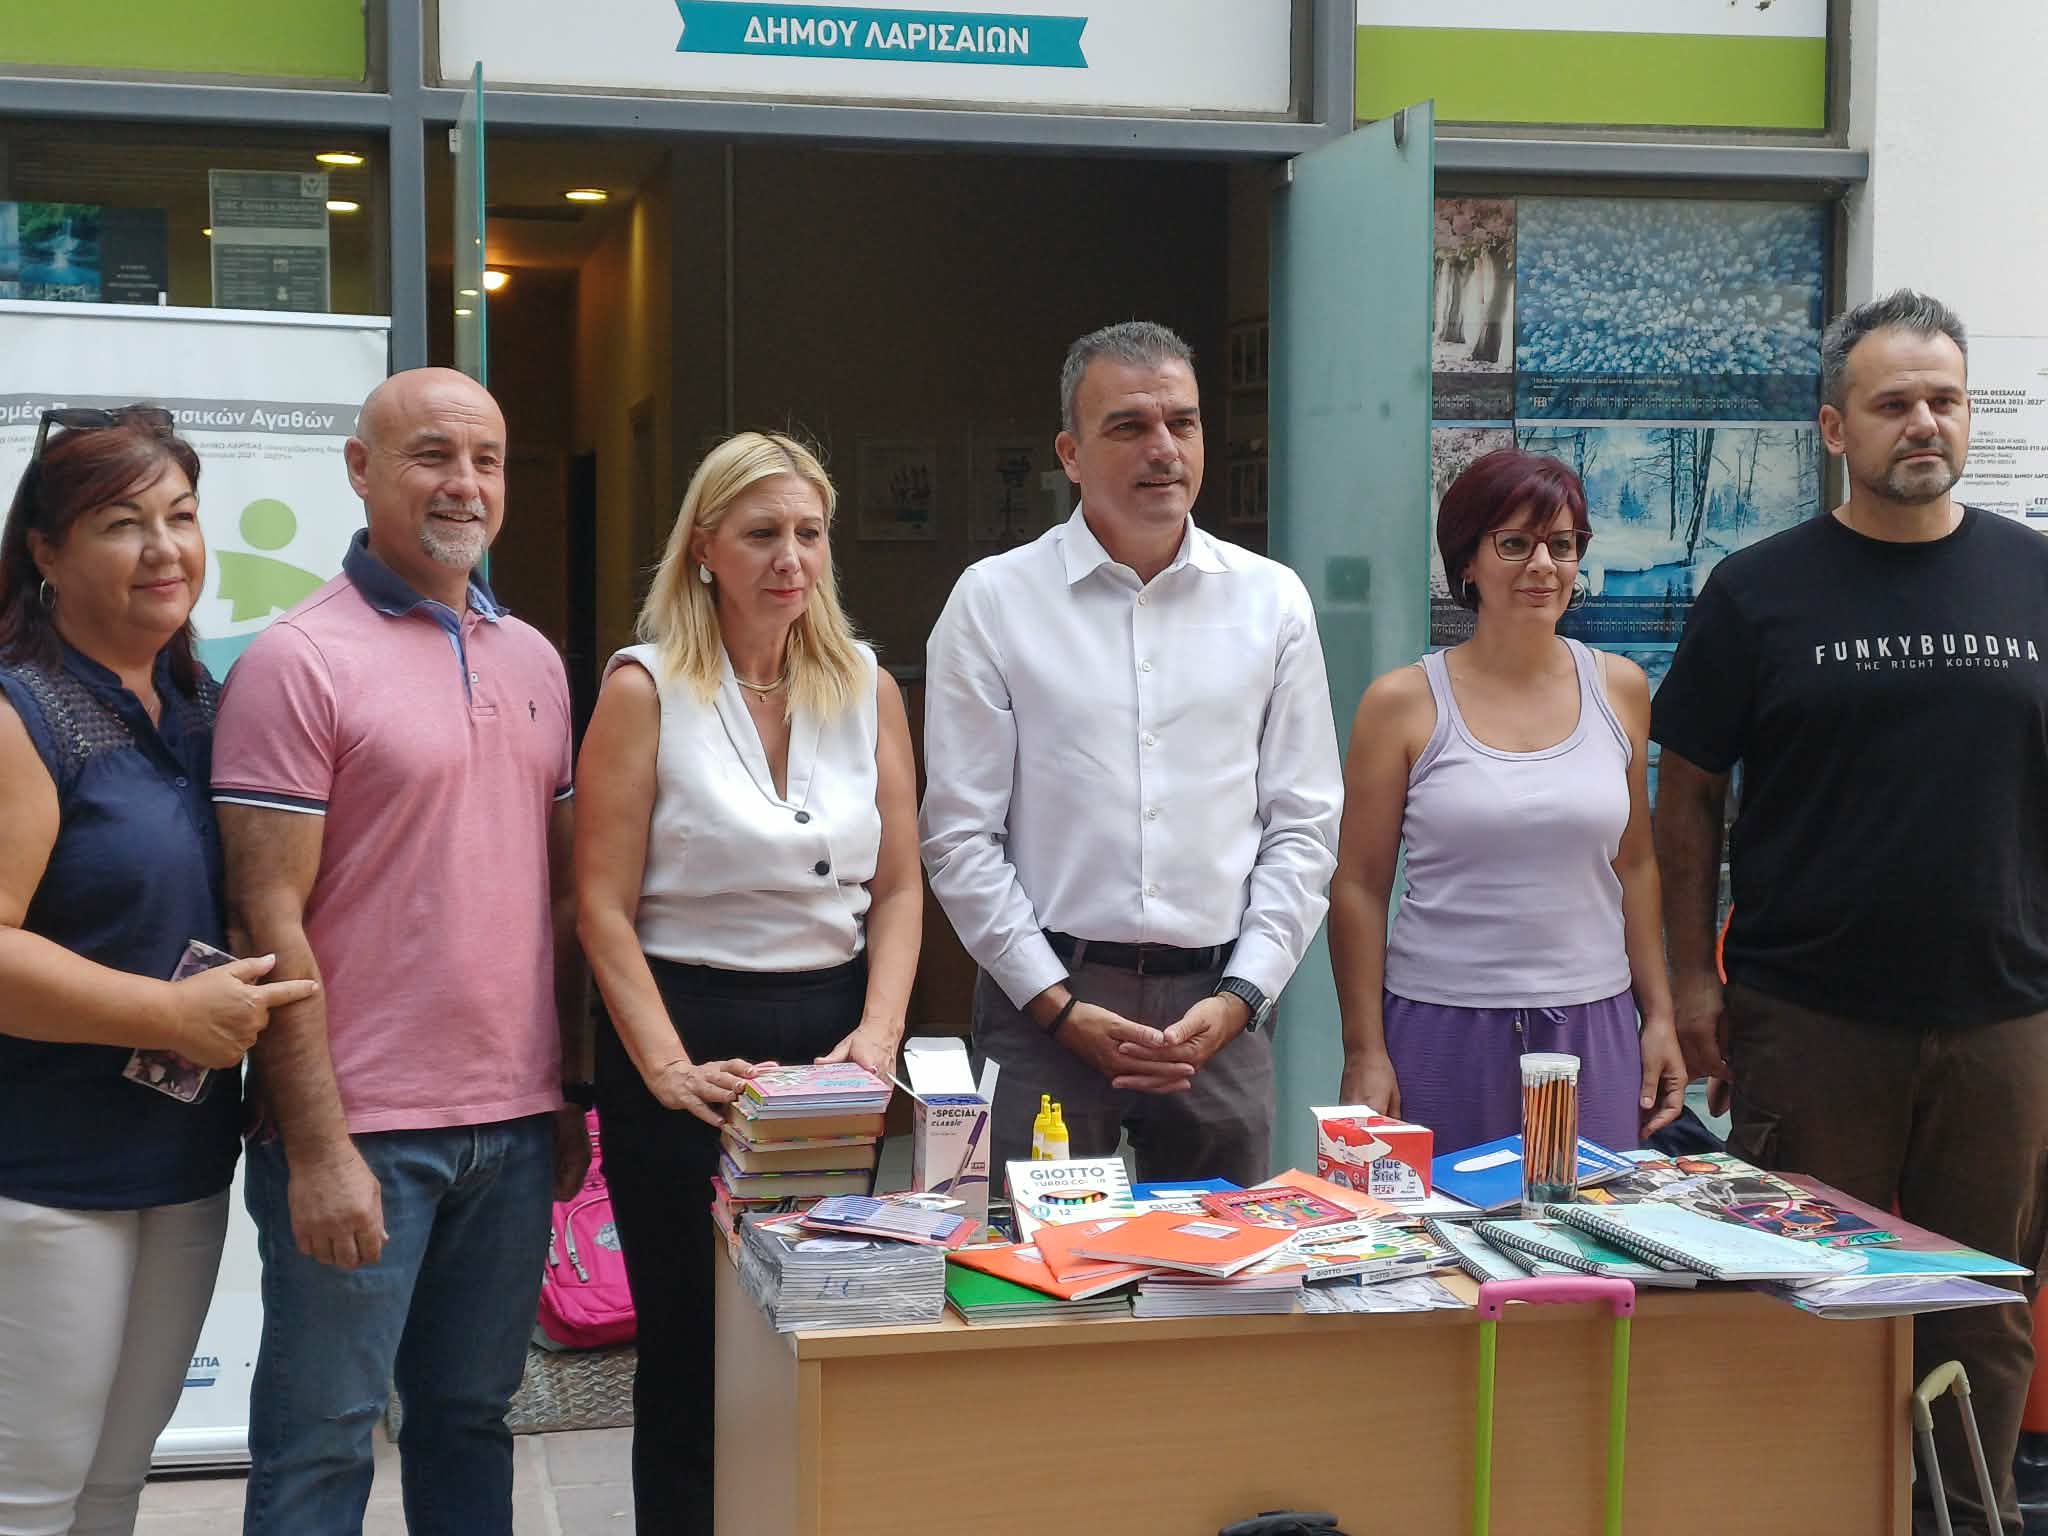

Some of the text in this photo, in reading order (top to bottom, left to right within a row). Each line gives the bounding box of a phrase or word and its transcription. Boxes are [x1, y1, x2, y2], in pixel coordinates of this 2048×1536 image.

[743, 15, 1030, 54] ΔΗΜΟΥ ΛΑΡΙΣΑΙΩΝ
[169, 407, 246, 426] ασικών
[250, 408, 335, 431] Αγαθών
[1815, 633, 2039, 665] FUNKYBUDDHA
[1855, 661, 1881, 672] THE
[1891, 658, 1935, 670] RIGHT
[1372, 1159, 1401, 1169] Glue
[1030, 1166, 1105, 1180] GIOTTO
[1372, 1169, 1401, 1181] Stick
[1059, 1208, 1071, 1216] 12
[192, 1356, 220, 1368] ΣΠΑ
